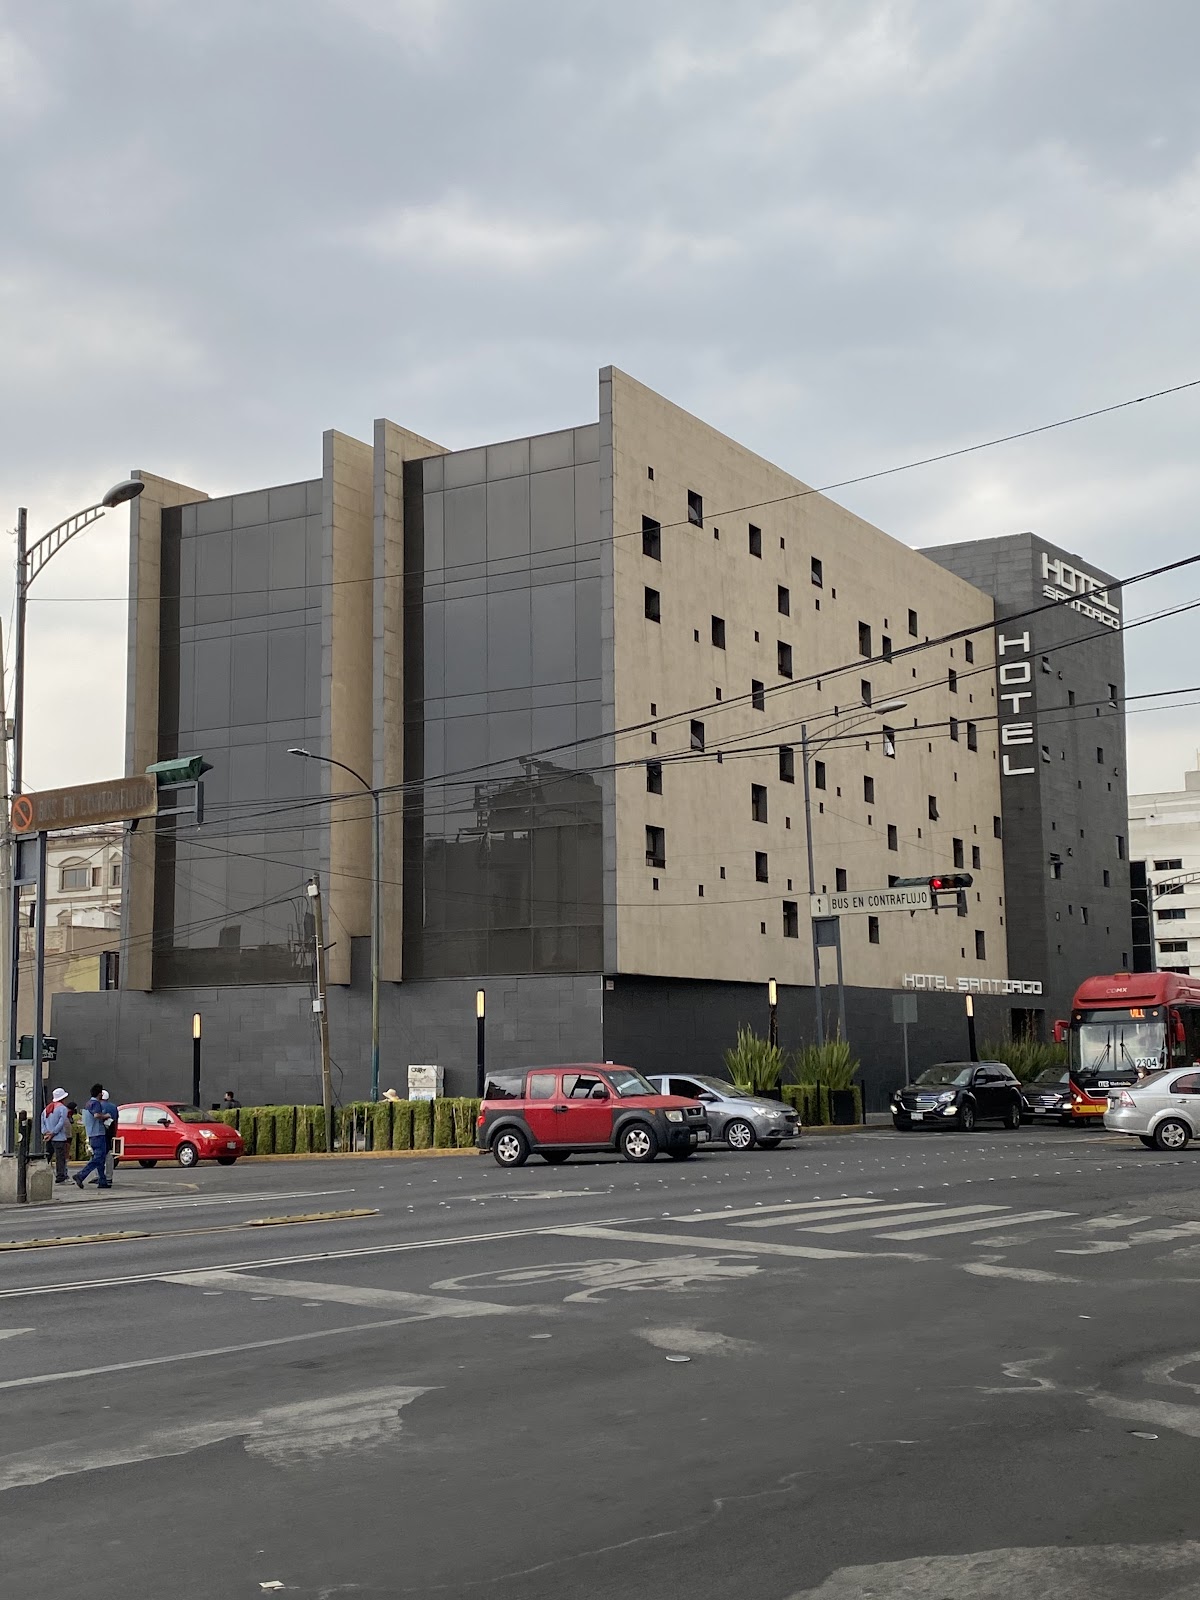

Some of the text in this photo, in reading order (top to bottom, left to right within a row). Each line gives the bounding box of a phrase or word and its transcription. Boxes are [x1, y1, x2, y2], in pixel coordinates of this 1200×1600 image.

[1042, 552, 1120, 614] HOTEL
[998, 631, 1035, 776] HOTEL
[832, 891, 928, 910] BUS EN CONTRAFLUJO
[903, 973, 1043, 994] HOTEL SANTIAGO
[1136, 1057, 1157, 1068] 2304
